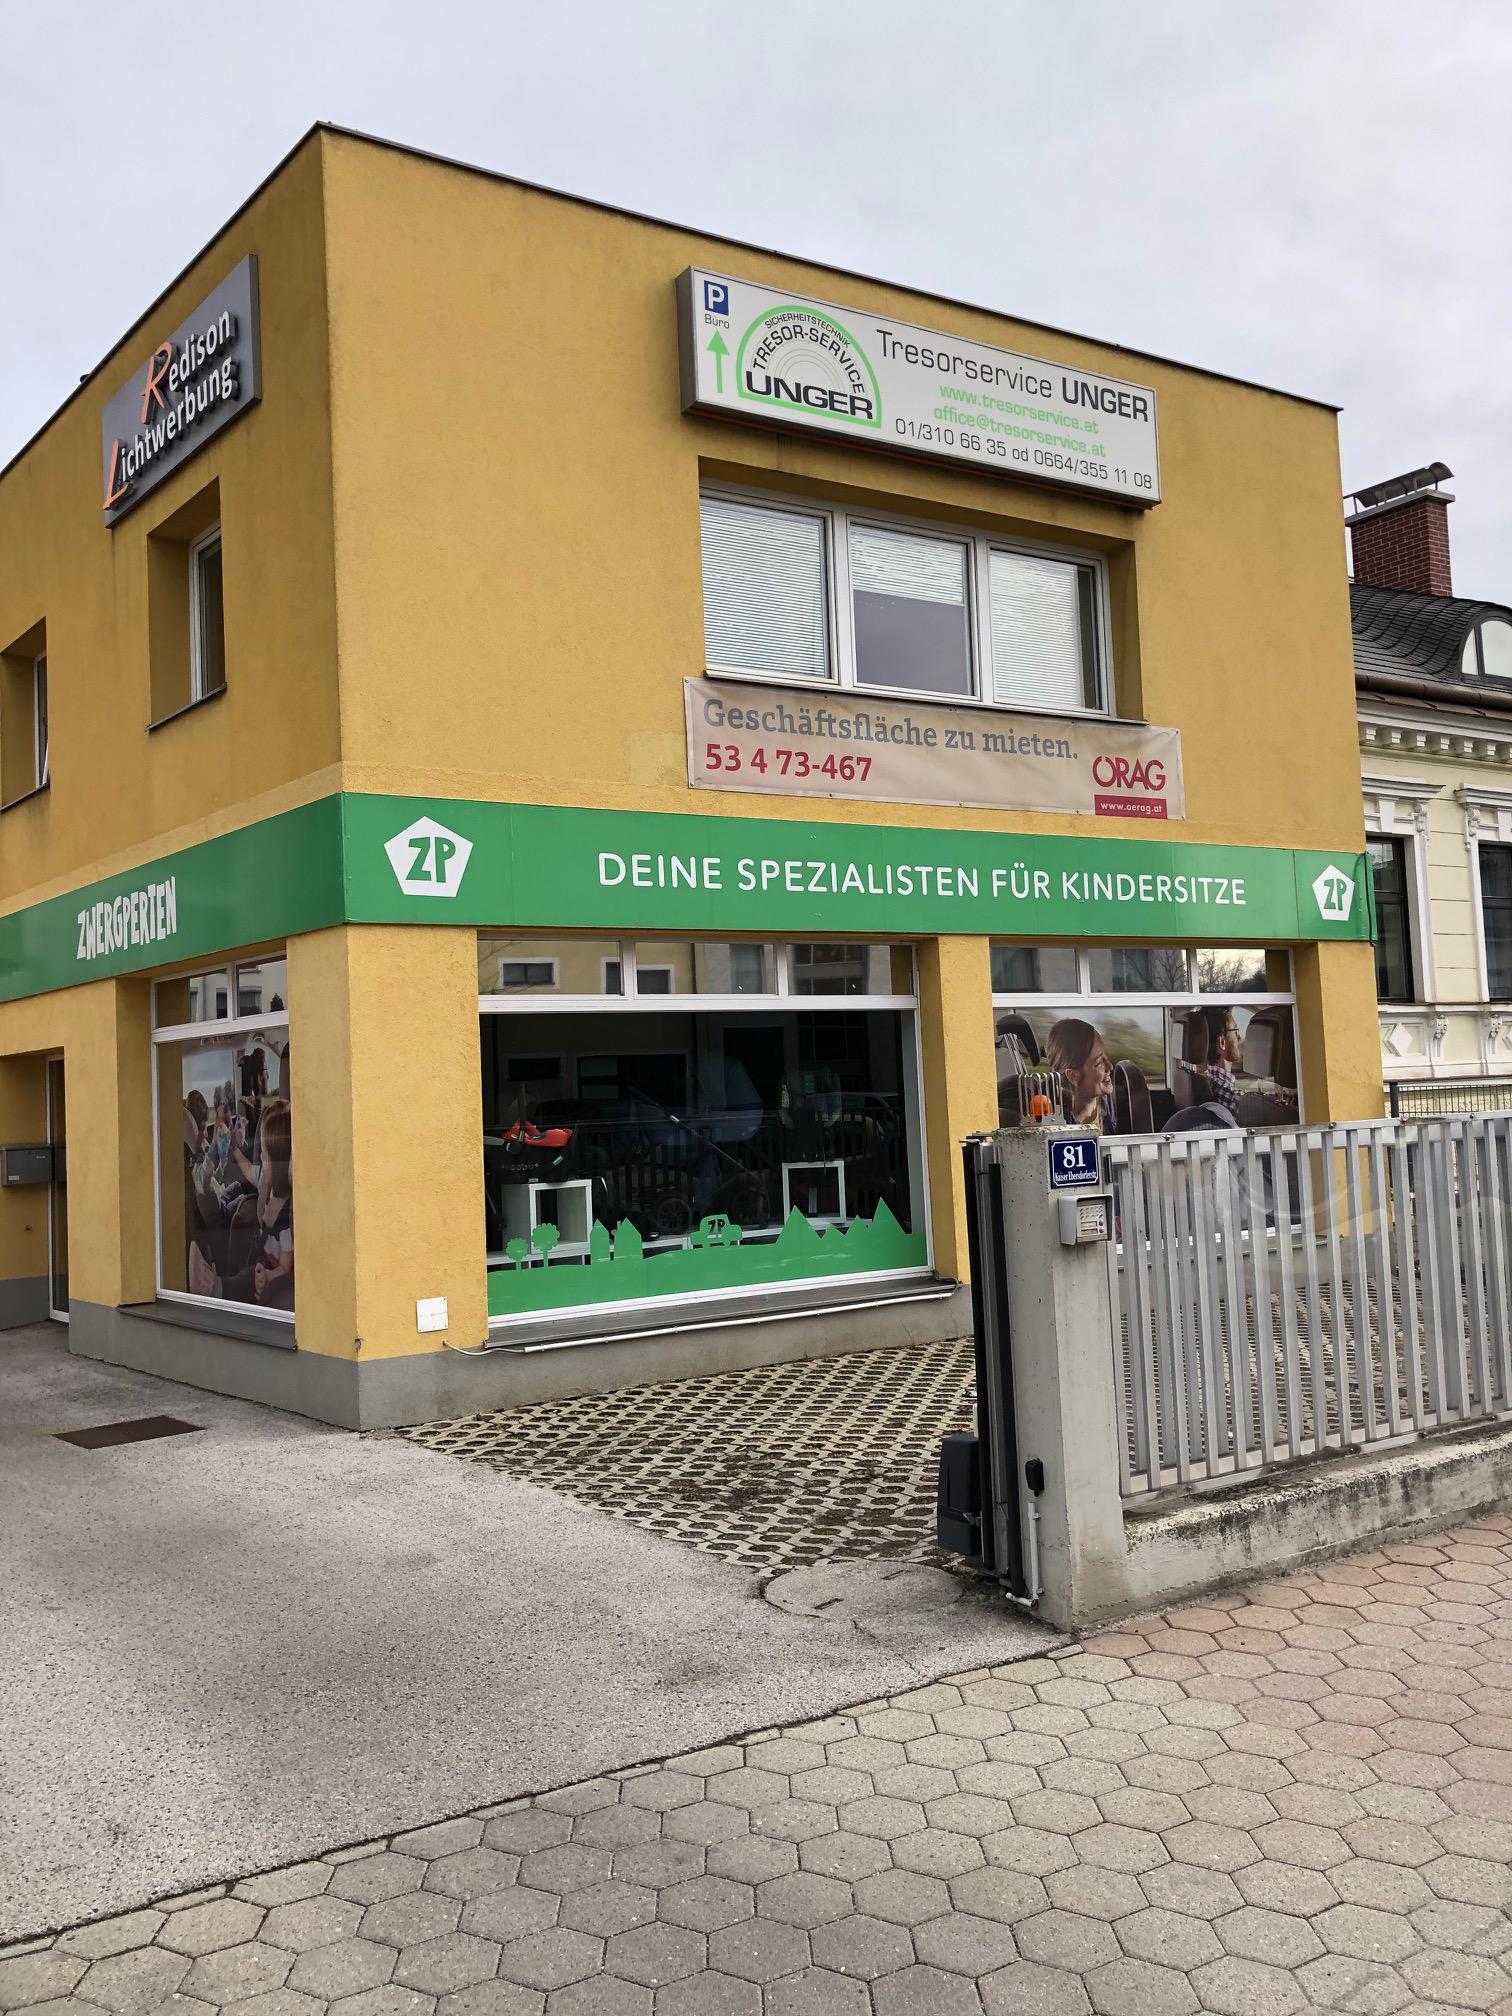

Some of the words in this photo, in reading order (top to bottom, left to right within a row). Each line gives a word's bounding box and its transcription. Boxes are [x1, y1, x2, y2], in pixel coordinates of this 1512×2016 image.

[704, 313, 730, 329] Büro
[765, 313, 850, 350] SICHERHEITSTECHNIK
[139, 309, 235, 425] Redison
[753, 324, 865, 394] TRESOR-SERVICE
[876, 328, 1052, 398] Tresorservice
[1062, 377, 1149, 422] UNGER
[746, 370, 873, 420] UNGER
[939, 385, 1099, 434] www.tresorservice.at
[102, 356, 236, 510] Lichtwerbung
[896, 418, 954, 445] 01/310
[960, 432, 981, 451] 66
[986, 438, 1007, 457] 35
[1012, 447, 1029, 462] od
[1034, 449, 1108, 480] 0664/355
[1114, 468, 1127, 484] 11
[1134, 472, 1152, 489] 08
[934, 405, 1106, 457] office@tresorservice.at
[703, 698, 937, 747] Geschäftsfläche
[944, 729, 976, 750] zu
[982, 728, 1078, 759] mieten.
[706, 743, 741, 771] 53
[750, 748, 768, 774] 4
[776, 749, 872, 781] 73-467
[1100, 802, 1162, 815] www.oerag.at
[405, 836, 456, 884] ZP
[598, 852, 723, 890] DEINE
[737, 858, 979, 897] SPEZIALISTEN
[992, 862, 1050, 899] FÜR
[1062, 872, 1247, 906] KINDERSITZE
[76, 876, 177, 960] ZWERGPERTEN
[1323, 878, 1347, 912] ZP
[1063, 1145, 1086, 1168] 81
